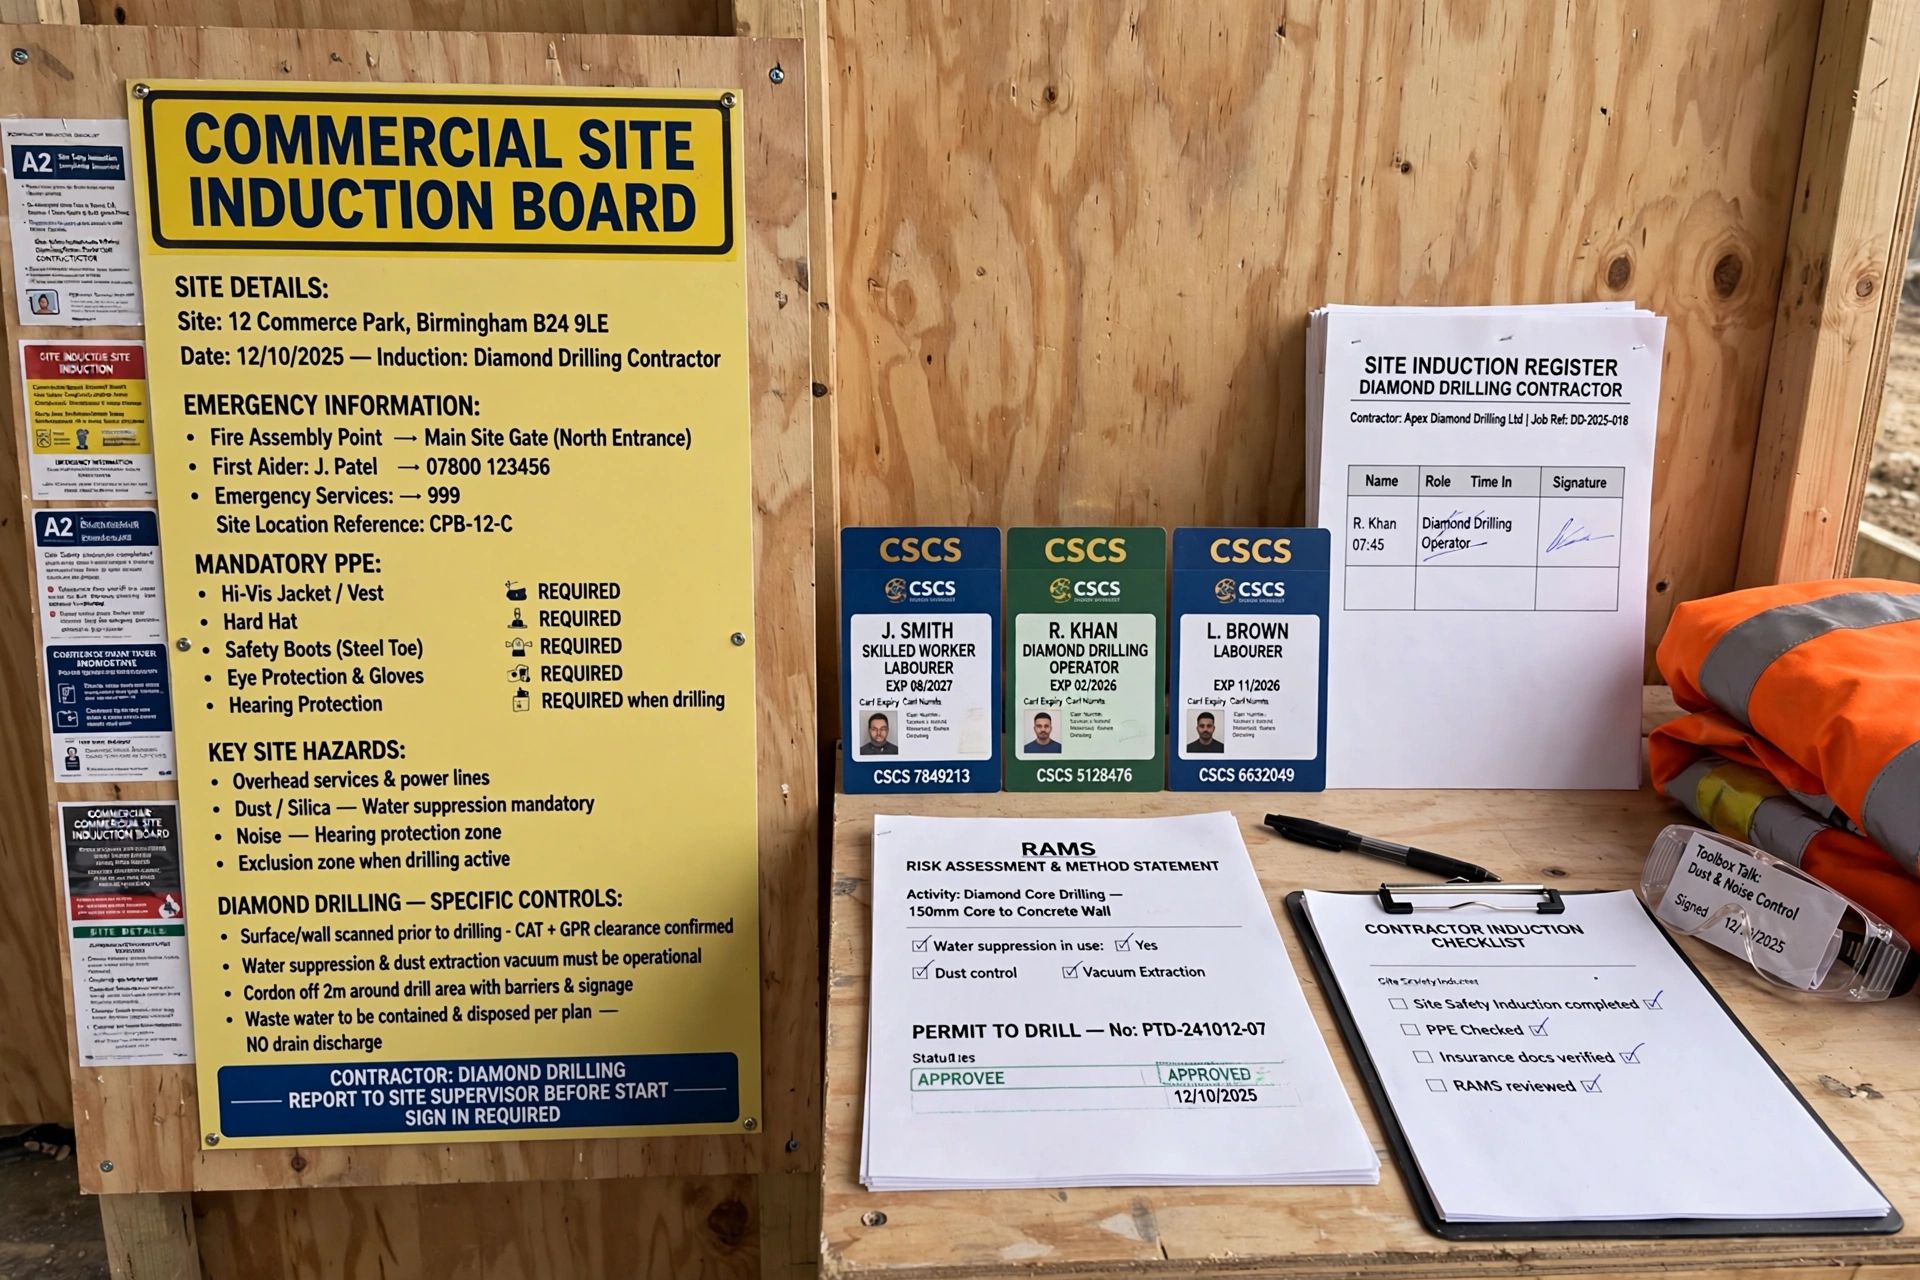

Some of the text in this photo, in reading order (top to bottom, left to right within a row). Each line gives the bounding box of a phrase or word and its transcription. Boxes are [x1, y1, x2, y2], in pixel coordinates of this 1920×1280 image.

[186, 112, 694, 170] COMMERCIAL SITE
[22, 151, 53, 173] A2
[190, 177, 696, 232] INDUCTION BOARD
[178, 310, 609, 337] Site: 12 Commerce Park, Birmingham B24 9LE
[1365, 356, 1618, 376] SITE INDUCTION REGISTER
[1360, 380, 1622, 397] DIAMOND DRILLING CONTRACTOR
[184, 394, 480, 416] EMERGENCY INFORMATION:
[1350, 412, 1629, 427] Contractor: Apex Diamond Drilling Ltd Job Ref: DD-2025-018
[213, 457, 550, 475] First Aider: J. Patel 07800 123456
[1366, 474, 1398, 487] Name
[1426, 475, 1512, 488] Role Time In
[1553, 476, 1607, 492] Signature
[44, 517, 74, 537] A2
[1354, 517, 1396, 529] R. Khan
[1423, 516, 1512, 537] Diamond Drilling
[880, 538, 961, 562] CSCS
[1045, 538, 1126, 563] CSCS
[1211, 539, 1291, 563] CSCS
[1353, 538, 1384, 551] 07:45
[1422, 537, 1471, 552] Operator
[910, 581, 956, 596] CSCS
[1074, 582, 1120, 596] CSCS
[1239, 582, 1285, 597] CSCS
[882, 622, 953, 639] J. SMITH
[1050, 622, 1117, 639] R. KHAN
[1208, 622, 1288, 639] L. BROWN
[863, 644, 976, 658] SKILLED WORKER
[1023, 644, 1148, 657] DIAMOND DRILLING
[1214, 645, 1283, 658] LABOURER
[885, 661, 954, 675] LABOURER
[1050, 661, 1119, 674] OPERATOR
[887, 680, 908, 692] EXP
[1051, 679, 1117, 691] EXP 02/2026
[1214, 679, 1280, 692] EXP 11/2026
[542, 690, 725, 711] REQUIRED when drilling
[874, 769, 970, 784] CSCS 7849213
[1037, 768, 1132, 782] CSCS 5128476
[1200, 768, 1295, 782] CSCS 6632049
[1022, 842, 1096, 856] RAMS
[907, 861, 1219, 872] RISK ASSESSMENT & METHOD STATEMENT
[1697, 844, 1762, 883] Toolbox Talk:
[907, 889, 1106, 902] Activity: Diamond Core Drilling
[1688, 862, 1800, 921] Dust & Noise Control
[910, 906, 1111, 917] 150mm Core to Concrete Wall
[1675, 893, 1709, 918] Signed
[241, 917, 734, 945] Surface/wall scanned prior to drilling CAT GPR clearance confirmed
[1365, 924, 1584, 935] CONTRACTOR INDUCTION
[1725, 917, 1786, 954] 12//2025
[934, 940, 1104, 954] Water suppression in use:
[1136, 940, 1158, 951] Yes
[1432, 938, 1525, 948] CHECKLIST
[936, 967, 1017, 979] Dust control
[1083, 966, 1206, 978] Vacuum Extraction
[1414, 999, 1640, 1012] Site Safety Induction completed
[913, 1022, 1265, 1039] PERMIT TO DRILL No: PTD-241012-07
[1426, 1024, 1524, 1035] PPE Checked
[1440, 1052, 1615, 1063] Insurance docs verified
[331, 1062, 625, 1086] CONTRACTOR: DIAMOND DRILLING
[918, 1072, 1005, 1086] APPROVEE
[1169, 1068, 1251, 1081] APPROVED
[1453, 1080, 1577, 1092] RAMS reviewed
[1175, 1088, 1257, 1104] 12/10/2025
